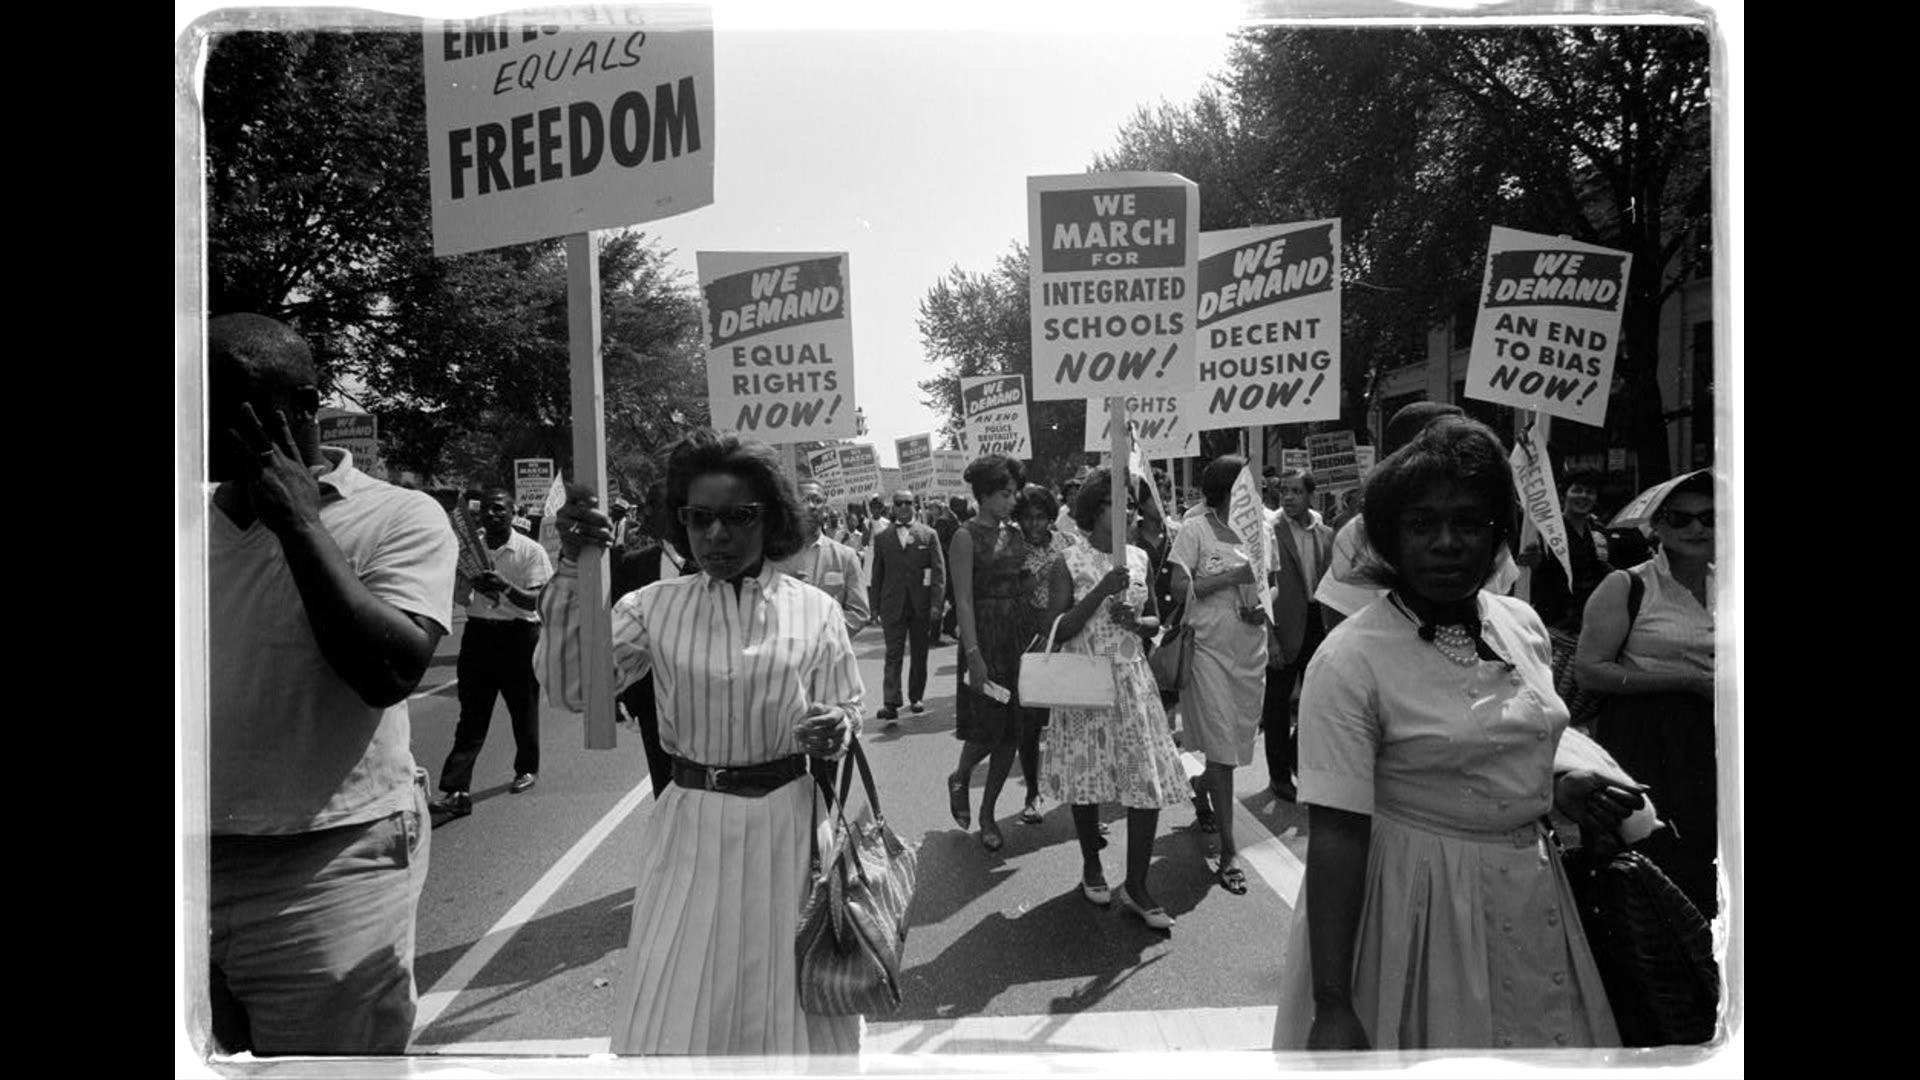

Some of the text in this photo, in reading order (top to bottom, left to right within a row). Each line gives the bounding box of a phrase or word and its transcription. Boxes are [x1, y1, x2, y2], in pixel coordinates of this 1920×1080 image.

[494, 31, 646, 95] EQUALS
[448, 75, 702, 200] FREEDOM
[1093, 193, 1136, 217] WE
[1052, 219, 1175, 249] MARCH
[1091, 252, 1139, 267] FOR
[1233, 238, 1286, 278] WE
[1533, 252, 1585, 276] WE
[751, 266, 799, 299] WE
[1043, 277, 1185, 306] INTEGRATED
[1198, 257, 1329, 322] DEMAND
[1495, 278, 1618, 303] DEMAND
[718, 286, 840, 339] DEMAND
[1044, 313, 1184, 341] SCHOOLS
[1211, 318, 1321, 349] DECENT
[1494, 313, 1608, 352] AN END
[732, 343, 833, 367] EQUAL
[1055, 343, 1178, 384] NOW!
[1199, 350, 1332, 382] HOUSING
[1494, 337, 1601, 377] TO BIAS
[732, 371, 837, 395] RIGHTS
[984, 381, 1004, 395] WE
[1208, 373, 1326, 414] NOW!
[1489, 364, 1599, 407] NOW!
[736, 394, 843, 432] NOW!
[970, 388, 1021, 414] DEMAND
[323, 426, 373, 440] DEMAND
[979, 436, 1025, 455] NOW!
